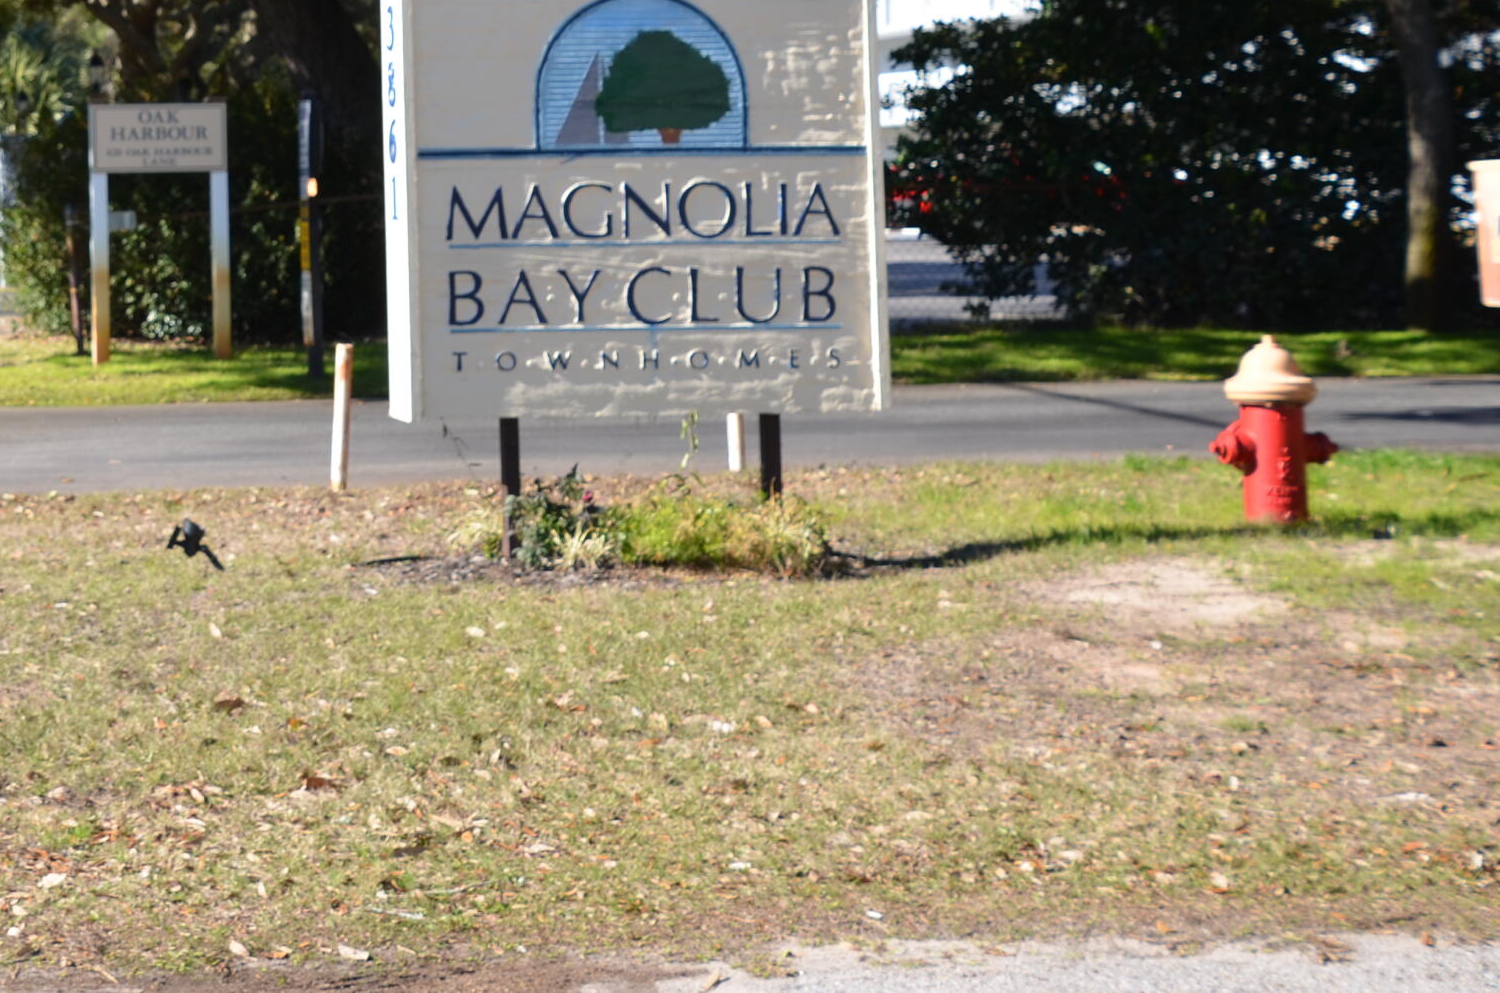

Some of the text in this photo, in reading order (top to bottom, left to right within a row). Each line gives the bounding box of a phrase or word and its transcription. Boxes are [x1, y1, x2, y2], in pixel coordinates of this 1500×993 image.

[138, 110, 178, 123] OAK
[110, 127, 208, 141] HARBOUR
[446, 181, 841, 240] MAGNOLIA
[448, 266, 840, 326] BAY CLUB
[452, 347, 841, 373] TOWNHOMES
